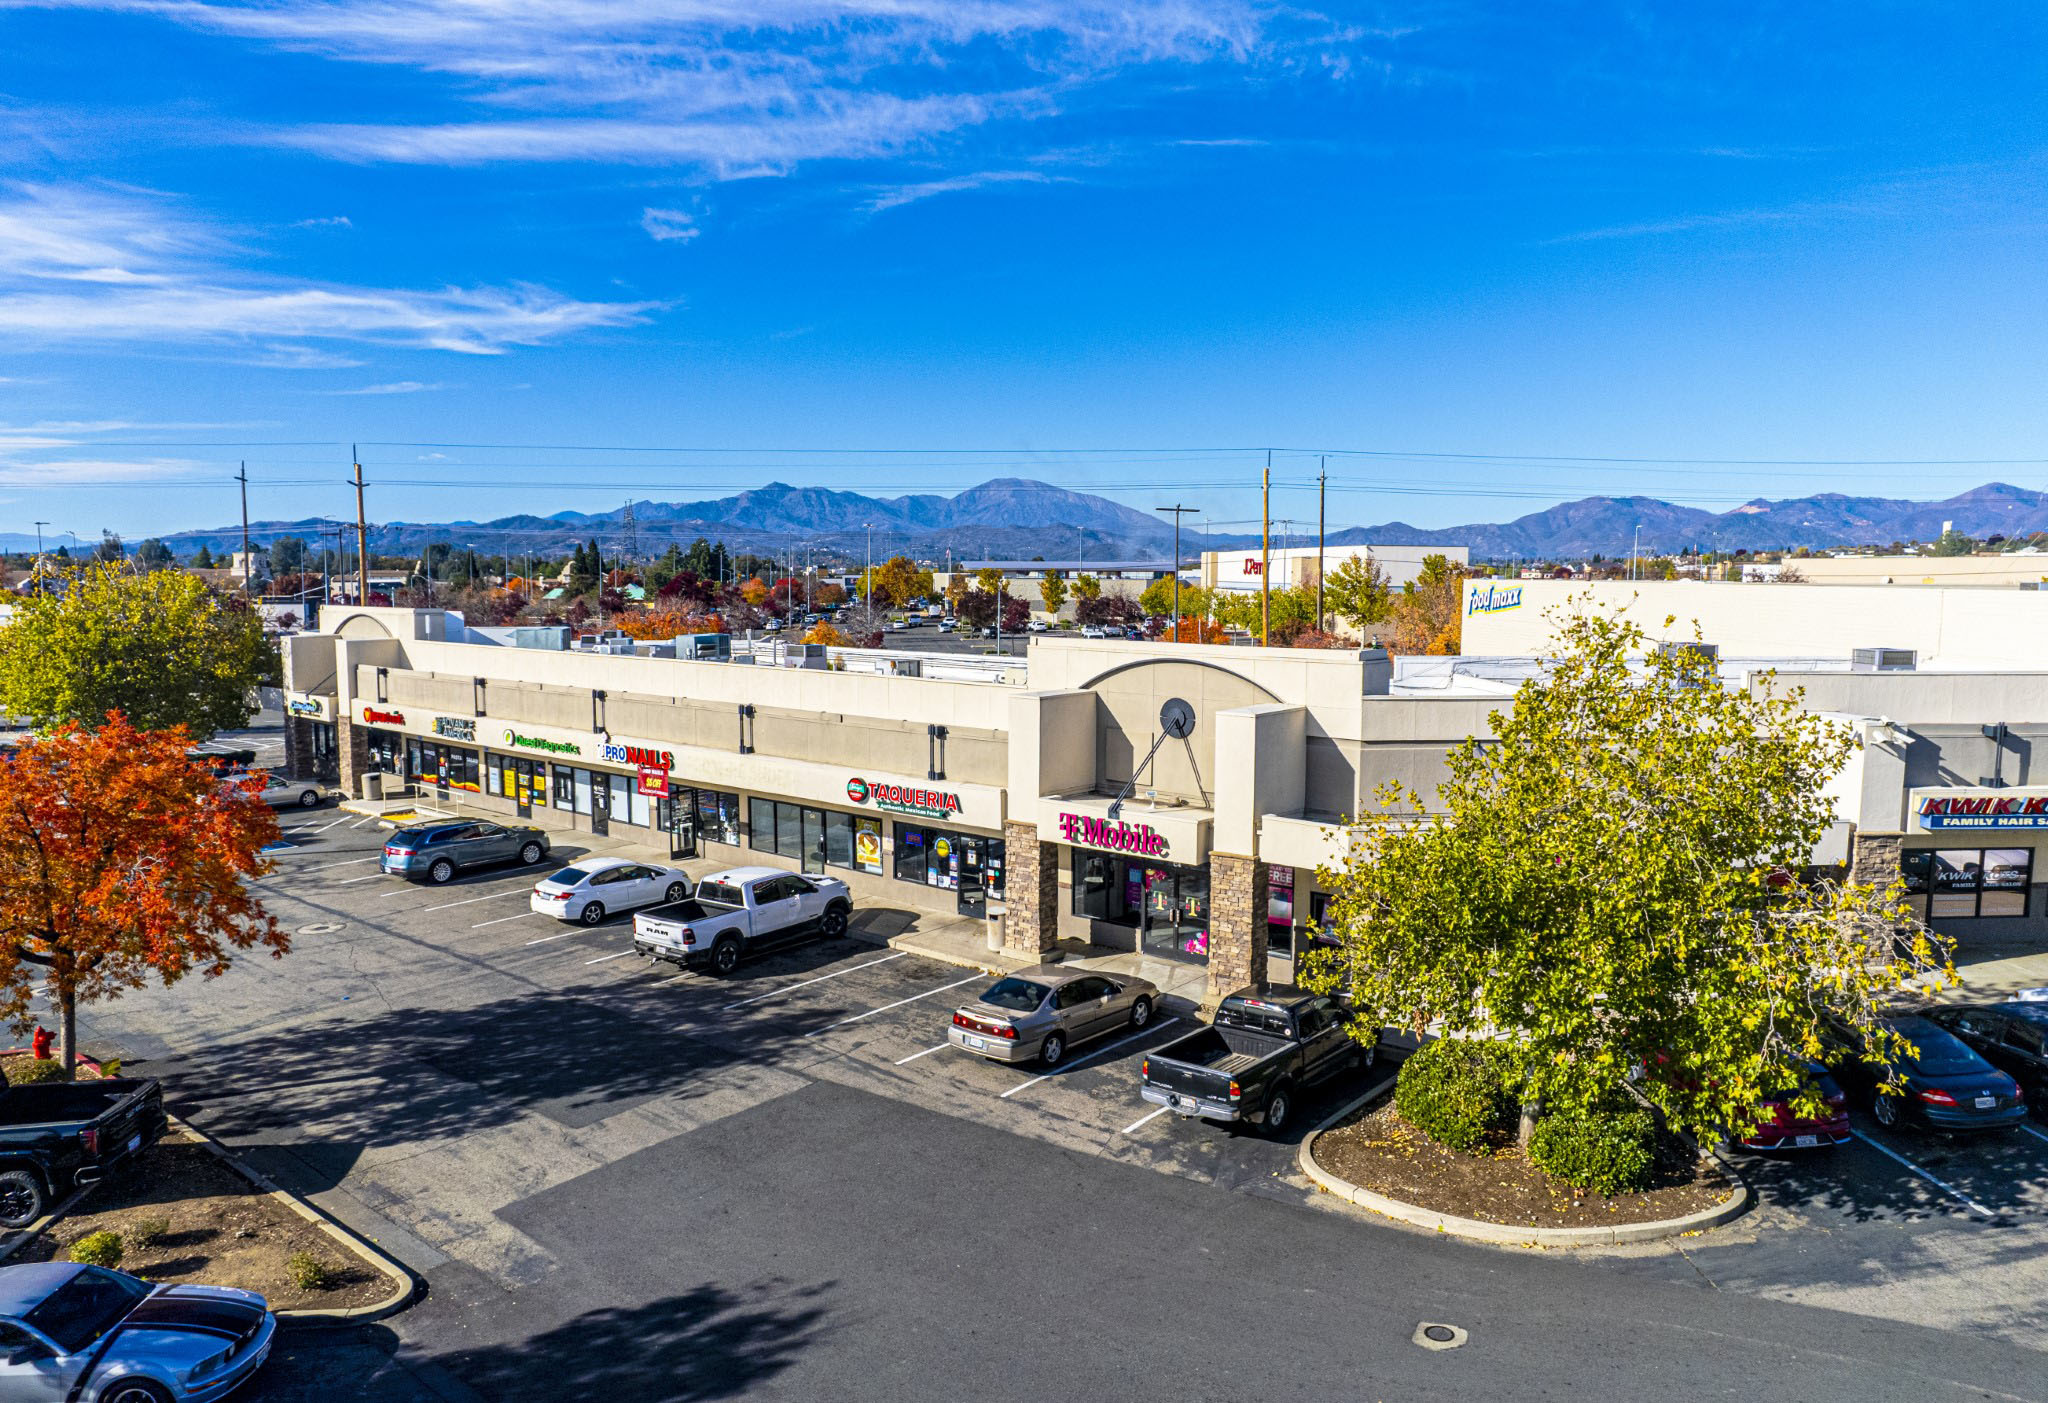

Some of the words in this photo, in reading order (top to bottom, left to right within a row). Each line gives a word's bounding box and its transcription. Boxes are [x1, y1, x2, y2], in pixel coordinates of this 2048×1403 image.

[1468, 584, 1495, 615] food
[1492, 587, 1522, 610] maxx
[442, 728, 473, 742] AMERICA
[605, 745, 626, 761] PRO
[626, 746, 672, 770] NAILS
[652, 778, 662, 788] OFF
[867, 783, 957, 811] TAQUERIA
[880, 803, 904, 812] Authentic
[905, 807, 926, 816] Mexican
[1920, 797, 2017, 814] KWIK
[1943, 817, 1993, 826] FAMILY
[1998, 817, 2033, 826] HAIR
[1269, 870, 1293, 883] FREE
[1938, 871, 1976, 881] KWIK
[646, 927, 669, 936] RAM
